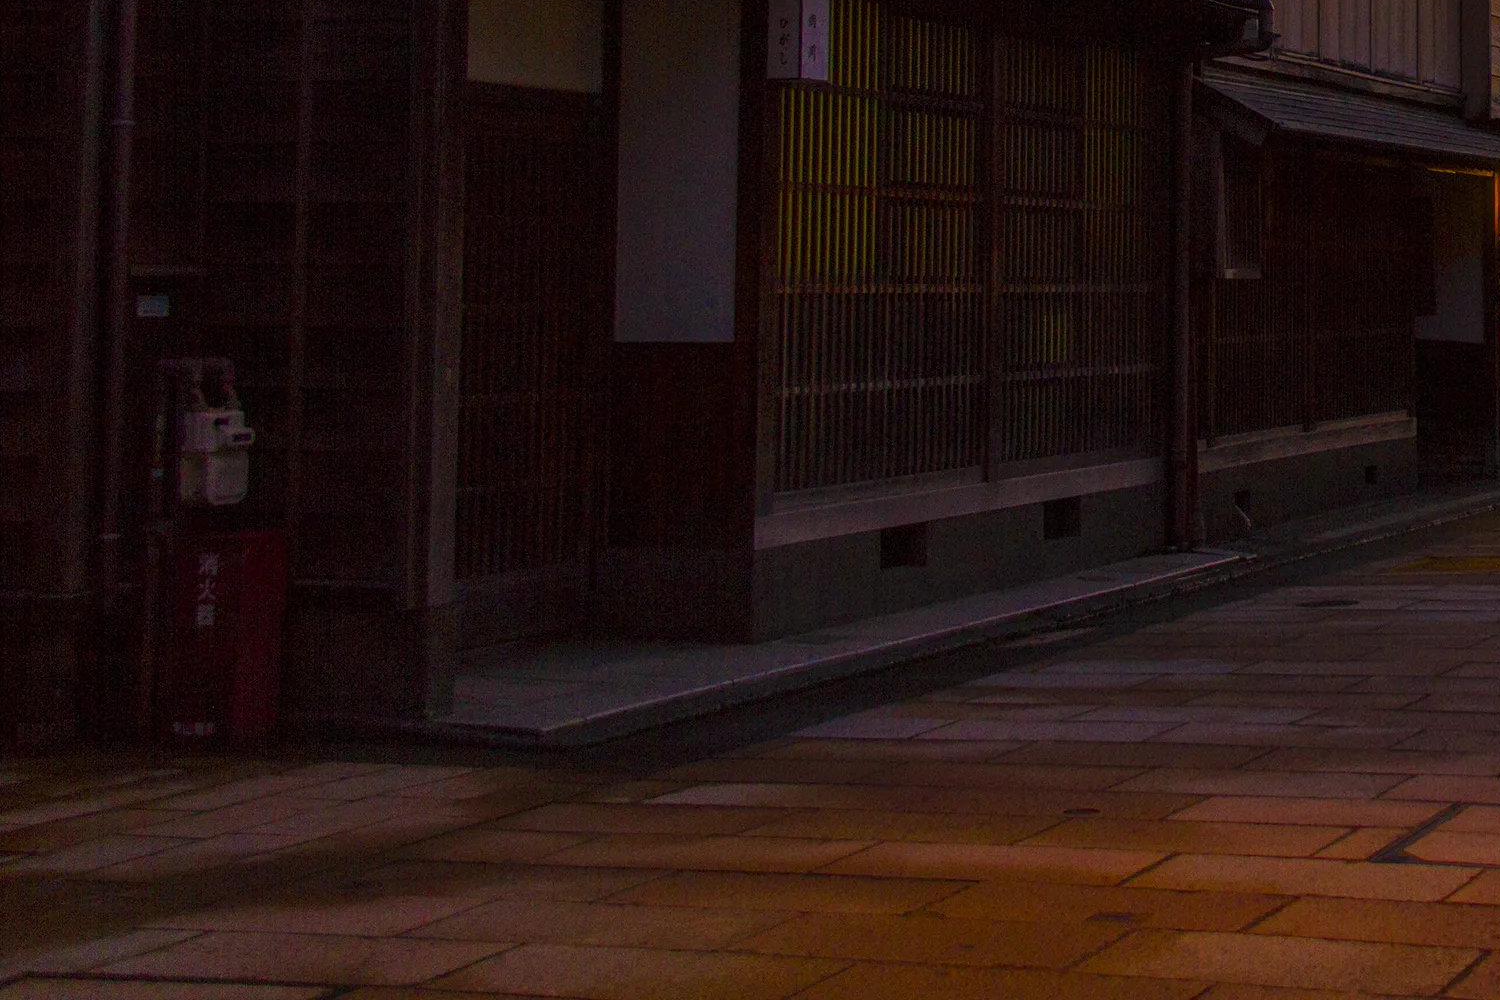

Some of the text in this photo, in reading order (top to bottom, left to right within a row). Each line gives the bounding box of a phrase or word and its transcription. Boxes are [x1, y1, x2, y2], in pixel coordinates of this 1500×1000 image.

[778, 17, 791, 66] ひがし
[196, 552, 219, 626] 消火器
